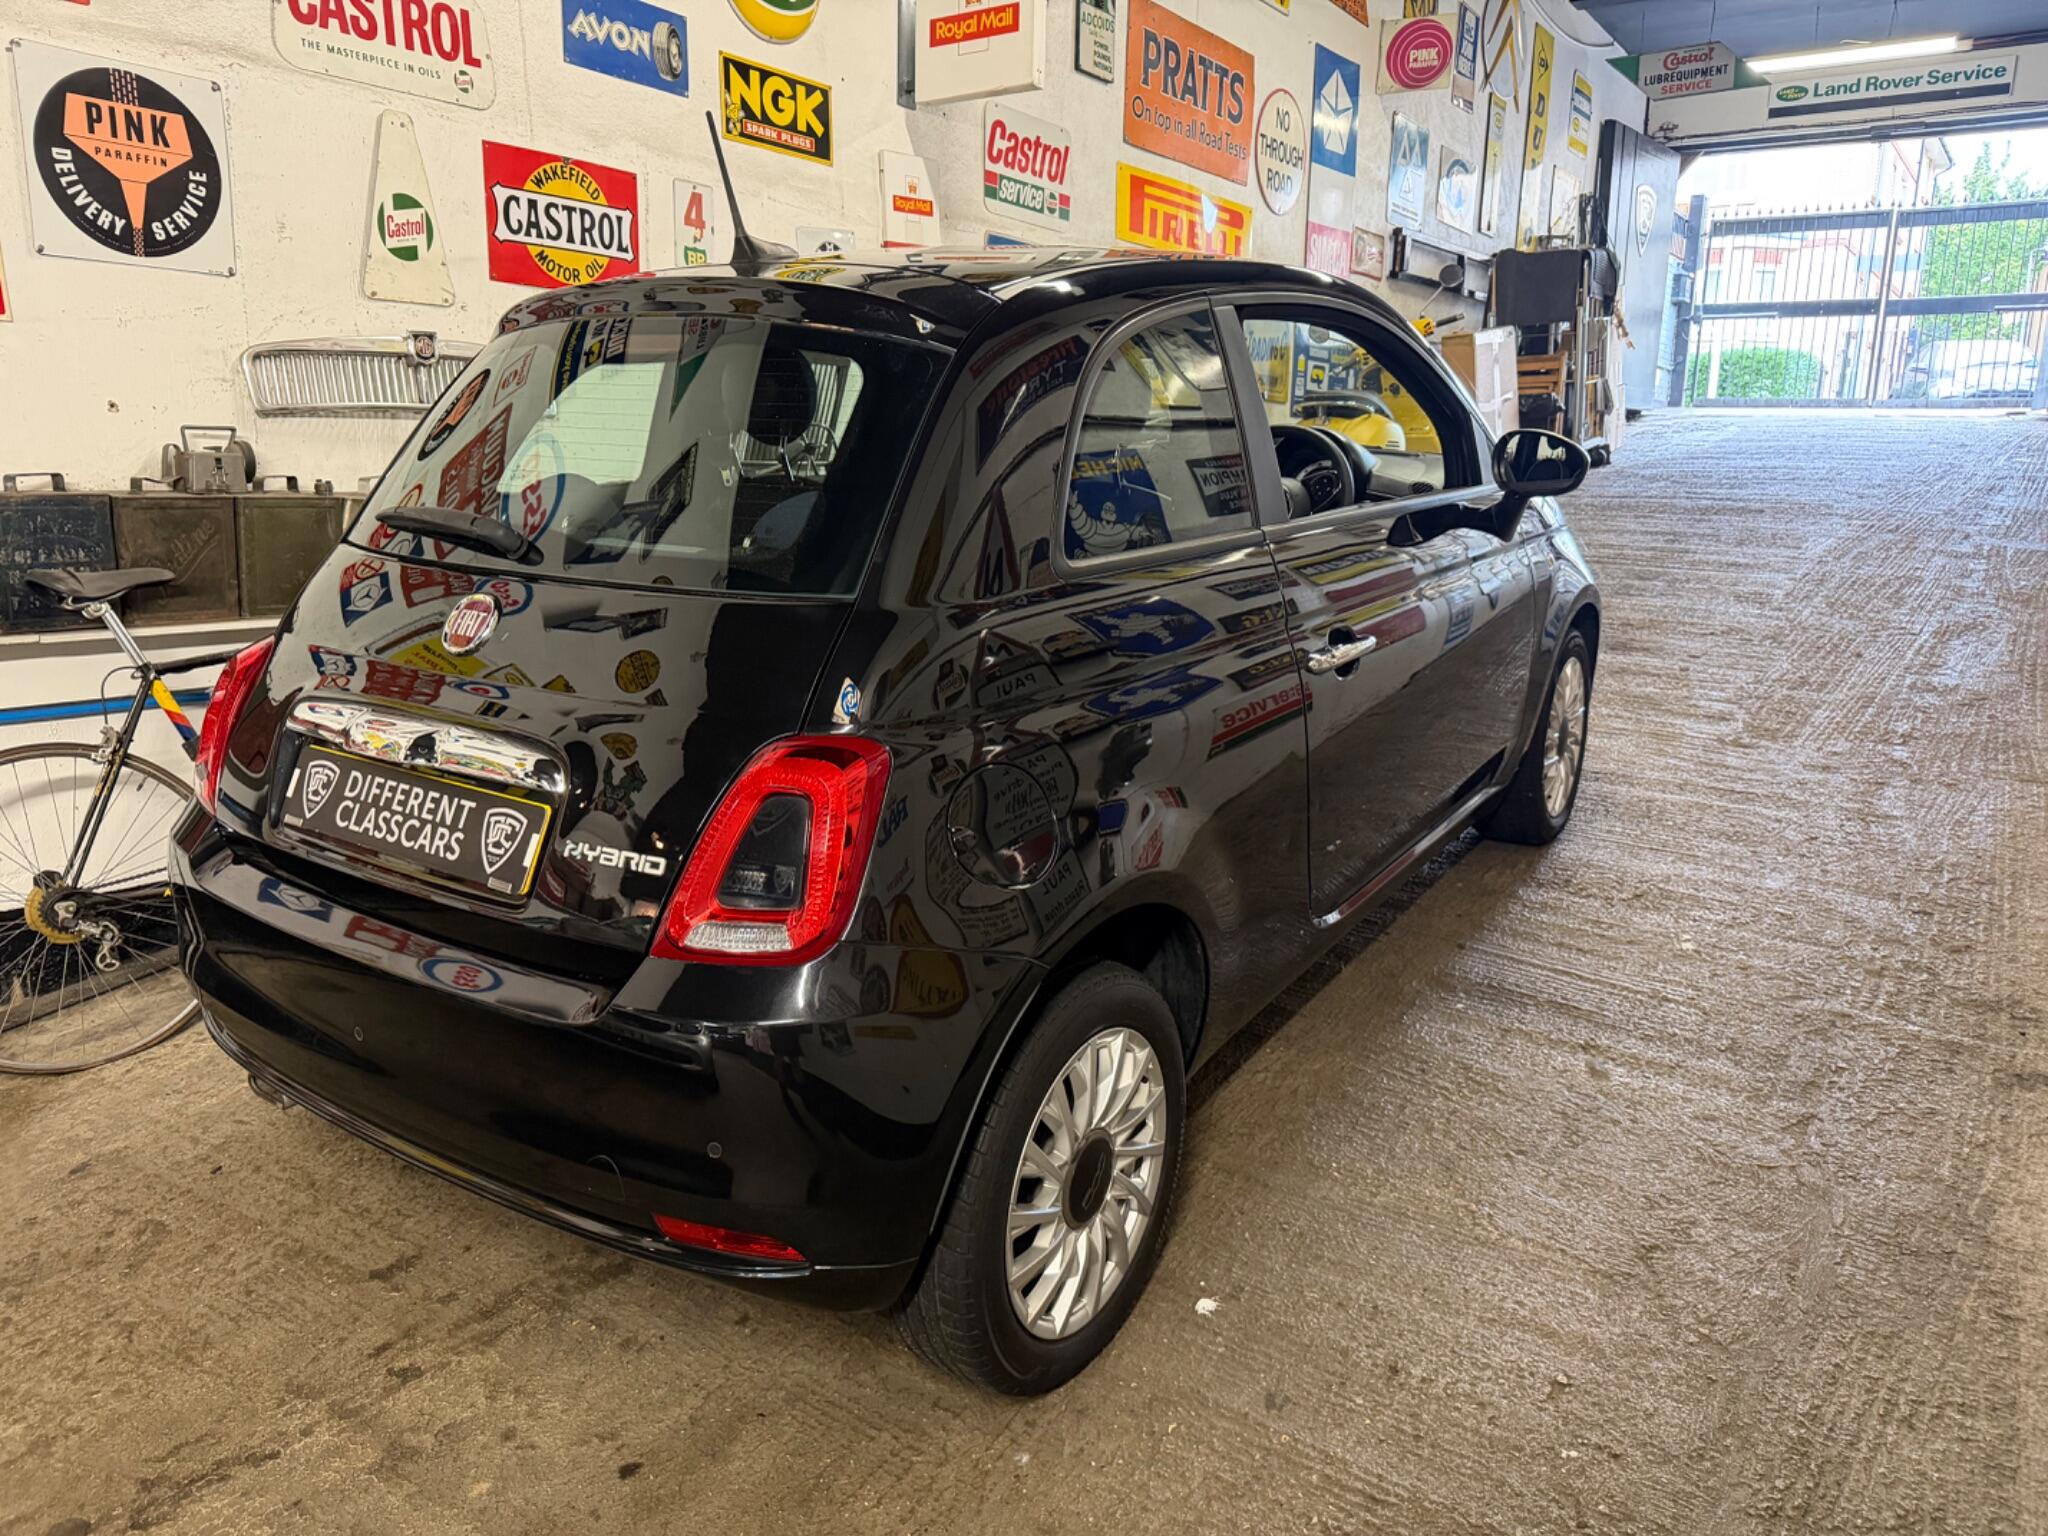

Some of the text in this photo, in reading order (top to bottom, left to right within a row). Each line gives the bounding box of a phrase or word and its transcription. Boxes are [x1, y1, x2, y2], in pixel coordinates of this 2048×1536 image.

[288, 0, 482, 69] CASTROL
[568, 8, 650, 60] AVON
[935, 8, 1013, 40] Royal Mail
[301, 38, 441, 80] THE MASTERPIECE IN OILS
[1409, 46, 1440, 64] PINK
[1664, 47, 1716, 71] Castrol
[1141, 27, 1245, 125] PRATTS
[1645, 64, 1729, 86] LUBREQUIPMENT
[1661, 79, 1713, 95] SERVICE
[1813, 63, 2007, 98] Land Rover Service
[729, 62, 825, 138] NGK
[85, 100, 170, 149] PINK
[746, 122, 813, 149] SPARK PLUGS
[1132, 96, 1248, 160] On top in all Road Tests
[1276, 106, 1290, 133] NO
[94, 145, 169, 168] PARAFFIN
[987, 118, 1070, 185] Castrol
[1260, 133, 1304, 170] THROUGH
[51, 146, 127, 237] DELIVERY
[151, 169, 208, 242] SERVICE
[530, 164, 601, 201] WAKEFIELD
[999, 178, 1044, 211] service
[1266, 167, 1293, 196] ROAD
[386, 212, 425, 239] Castrol
[503, 194, 630, 254] CASTROL
[684, 191, 706, 240] 4
[1130, 174, 1244, 257] PIRELLI
[534, 250, 605, 283] MOTOR OIL
[687, 251, 706, 265] BP
[451, 608, 488, 638] FIAT
[344, 770, 477, 829] DIFFERENT
[335, 800, 465, 862] CLASSCARS
[563, 840, 667, 876] HYBRID
